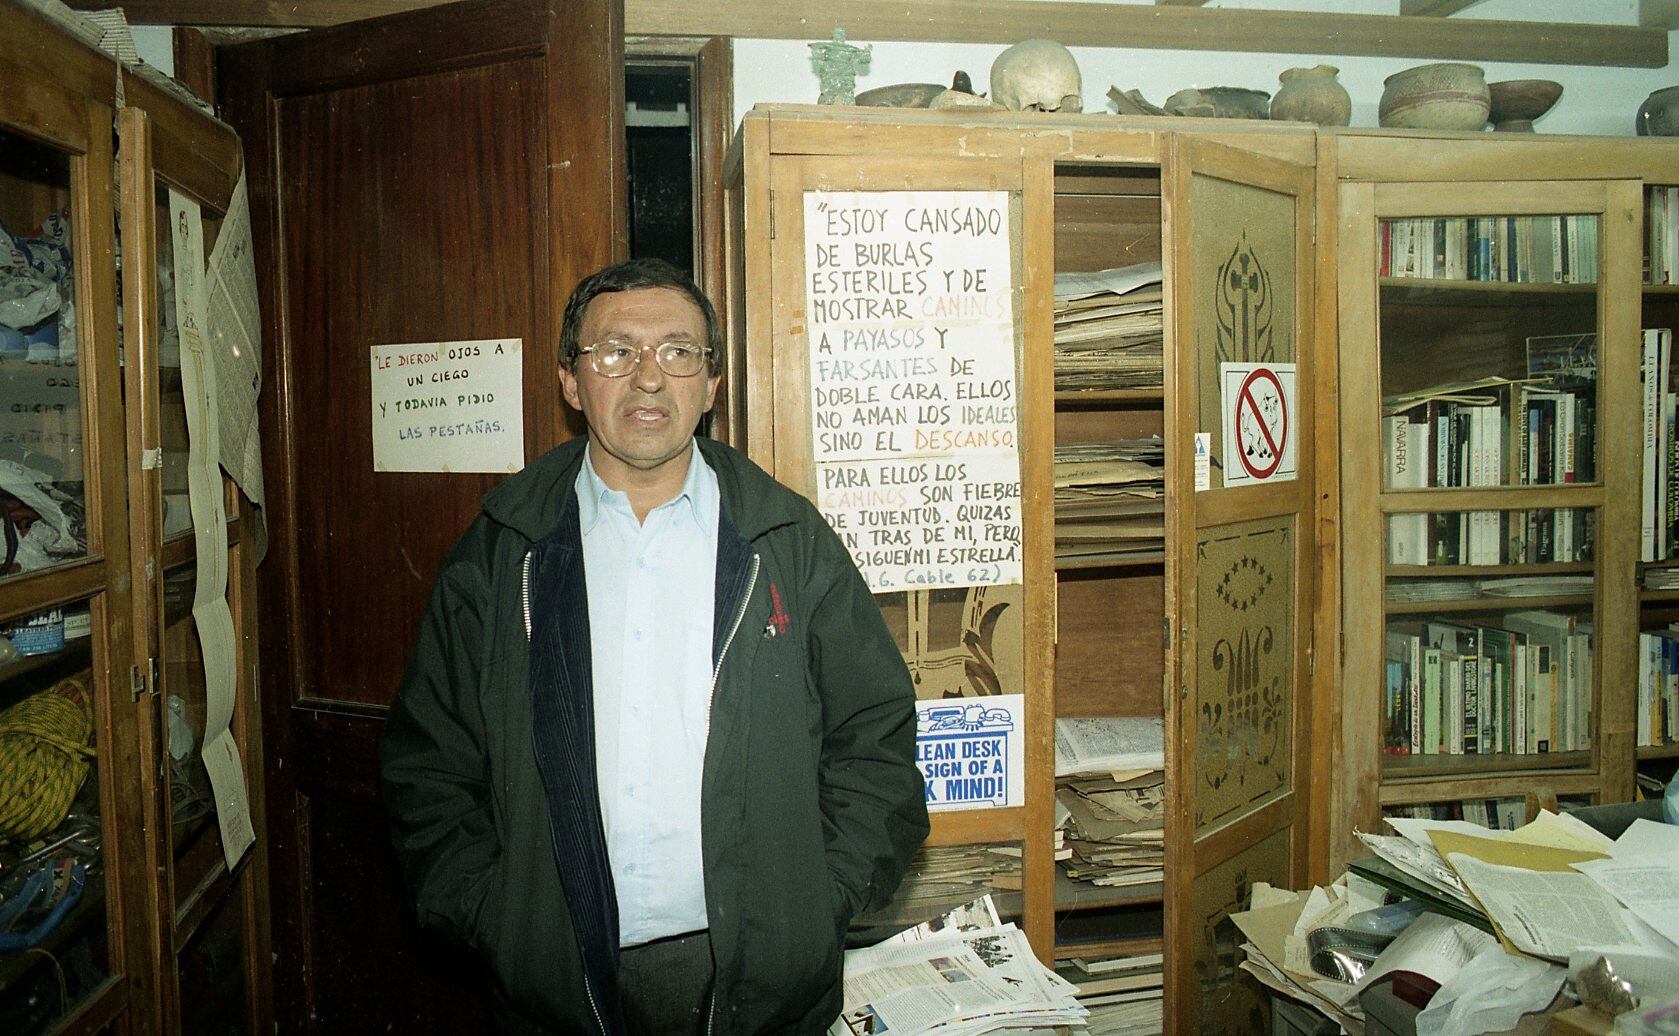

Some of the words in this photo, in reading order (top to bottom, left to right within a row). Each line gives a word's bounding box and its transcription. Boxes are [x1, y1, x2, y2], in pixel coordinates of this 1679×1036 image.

[904, 206, 1001, 237] CANSADO
[816, 243, 841, 268] DE
[855, 241, 934, 268] BURLAS
[812, 269, 928, 295] ESTERILES
[942, 269, 955, 293] Y
[963, 268, 987, 293] DE
[813, 297, 913, 324] MOSTRAR
[818, 331, 832, 355] A
[842, 326, 926, 352] PAYASOS
[933, 326, 949, 349] Y
[398, 351, 439, 367] DIERON
[448, 345, 481, 360] OJOS
[494, 343, 504, 355] A
[407, 374, 423, 387] UN
[431, 369, 469, 383] CIEGO
[815, 356, 938, 383] FARSANTES
[949, 356, 975, 377] DE
[379, 402, 387, 418] Y
[395, 397, 447, 413] TODAVIA
[457, 393, 494, 407] PIDIO
[814, 384, 881, 408] DOBLE
[890, 383, 949, 401] CARA.
[956, 379, 1012, 402] ELLOS
[816, 411, 843, 429] NO
[851, 406, 908, 427] AMAN
[917, 405, 951, 425] LOS
[961, 404, 1016, 425] IDEALES
[399, 427, 423, 441] LAS
[819, 431, 863, 453] SINO
[875, 431, 902, 452] EL
[1396, 420, 1406, 474] NAVARRA
[823, 467, 871, 489] PARA
[879, 463, 929, 485] ELLOS
[935, 463, 967, 482] LOS
[919, 485, 953, 505] SON
[963, 482, 1021, 501] FIEBRE
[825, 512, 848, 529] DE
[956, 504, 1012, 523] QUIZAS
[868, 529, 912, 546] TRAS
[923, 527, 945, 544] DE
[904, 567, 956, 585] Cable
[915, 742, 956, 761] LEAN
[962, 739, 1001, 759] DESK
[924, 761, 962, 779] SIGN
[968, 760, 988, 776] OF
[992, 759, 1003, 774] A
[945, 776, 1003, 801] MIND!
